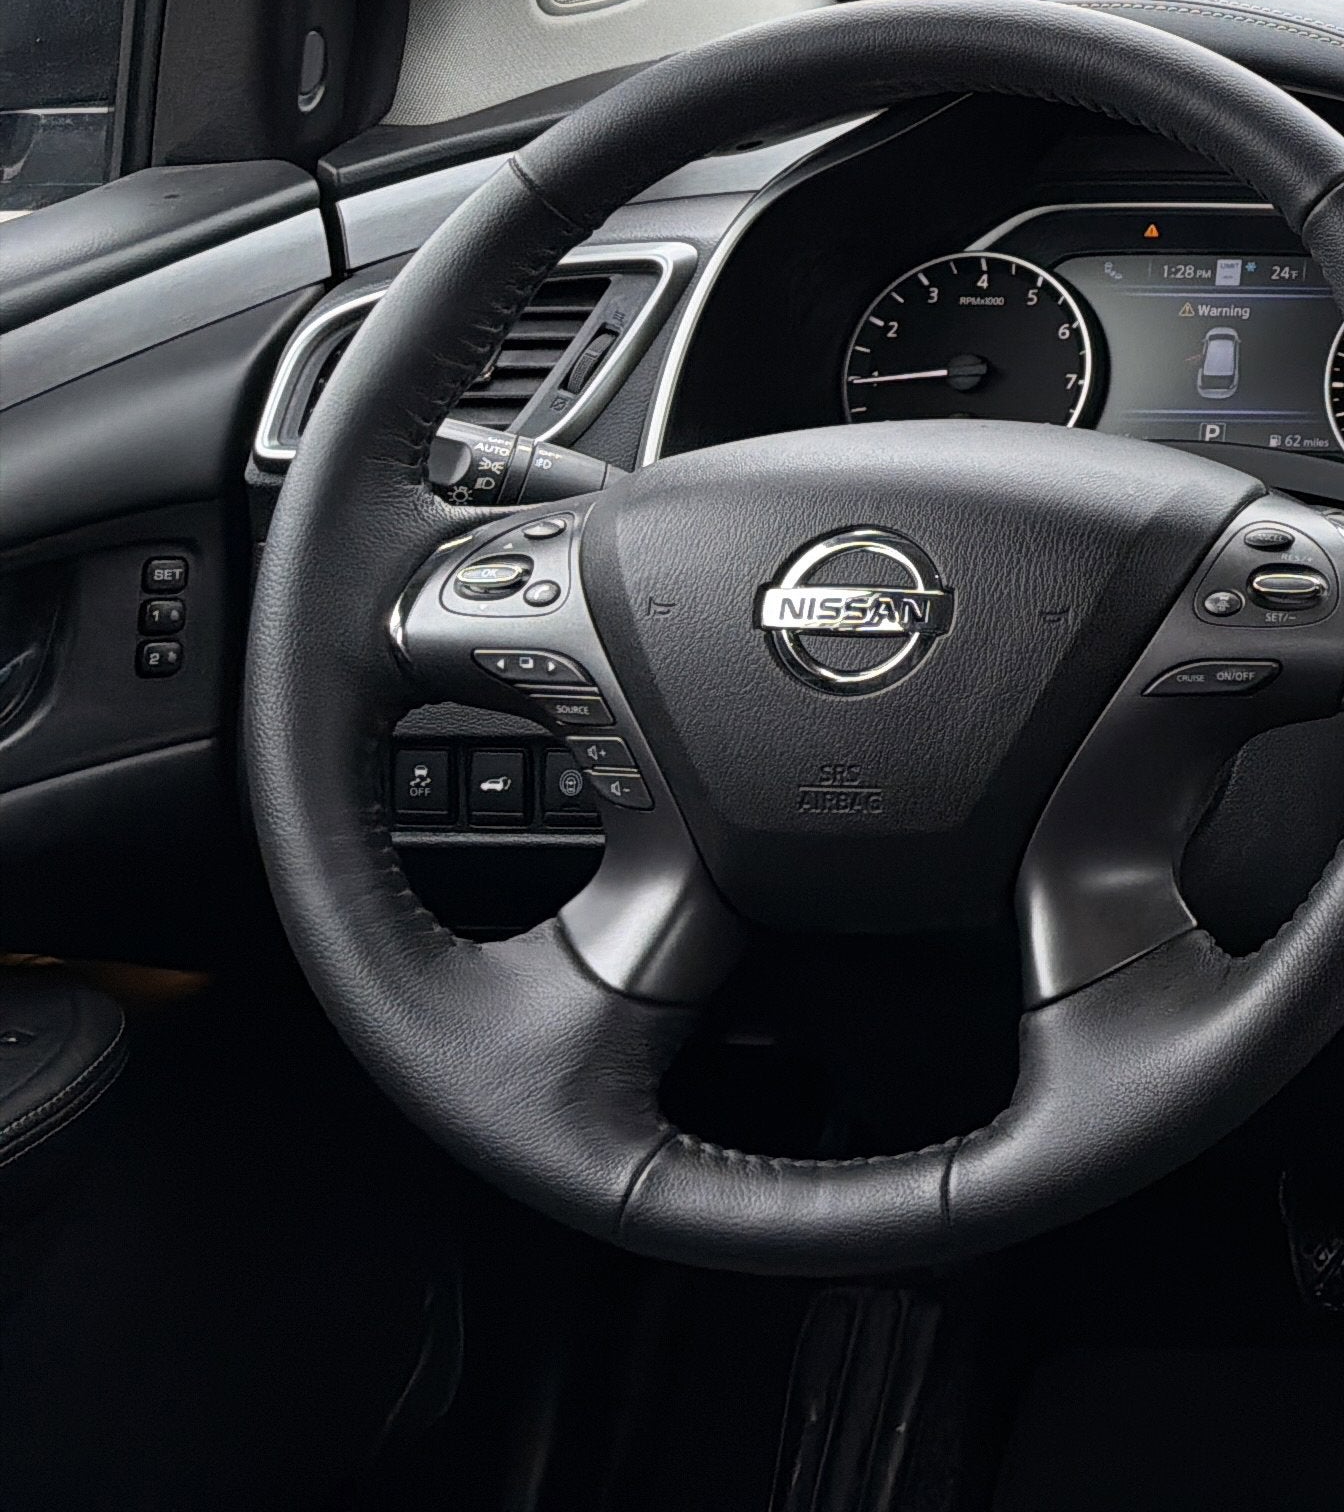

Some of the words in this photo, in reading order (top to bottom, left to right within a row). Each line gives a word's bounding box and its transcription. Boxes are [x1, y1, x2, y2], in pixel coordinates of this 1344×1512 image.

[1163, 264, 1194, 279] 1:28
[1196, 269, 1212, 279] PM
[977, 274, 989, 289] 4
[928, 288, 939, 303] 3
[1027, 289, 1038, 305] 5
[1198, 304, 1251, 319] Warning
[886, 322, 899, 338] 2
[1058, 324, 1070, 339] 6
[1066, 373, 1078, 390] 7
[1205, 424, 1221, 441] P
[475, 441, 511, 456] AUTO
[1284, 434, 1301, 447] 62
[1303, 436, 1329, 448] miles
[153, 569, 183, 581] SET
[482, 569, 497, 578] OK
[152, 610, 160, 622] 1
[780, 597, 931, 624] NISSAN
[149, 652, 160, 664] 2
[1176, 674, 1205, 683] CRUISE
[1216, 672, 1257, 681] ON/OFF
[556, 704, 589, 715] SOURCE
[819, 765, 861, 786] SRS
[410, 787, 431, 797] OFF
[799, 790, 882, 813] AIRBAG
